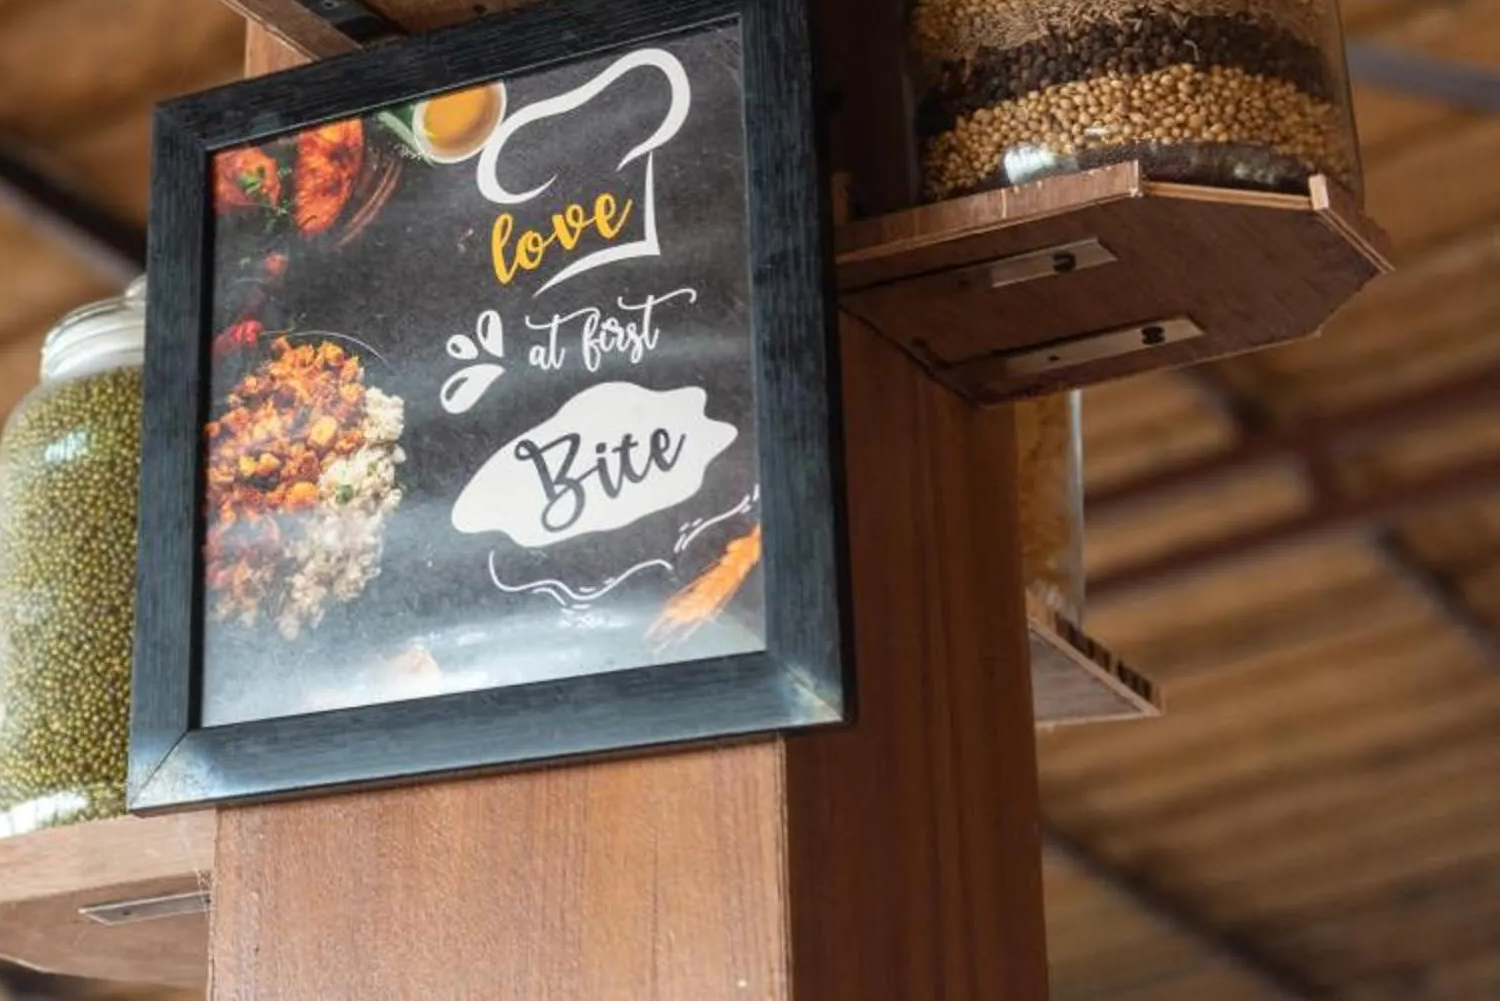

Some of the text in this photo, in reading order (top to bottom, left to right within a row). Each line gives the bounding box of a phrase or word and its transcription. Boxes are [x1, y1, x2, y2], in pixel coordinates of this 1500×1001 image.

[491, 192, 633, 283] love
[525, 289, 696, 372] at first
[514, 425, 686, 533] Bite
